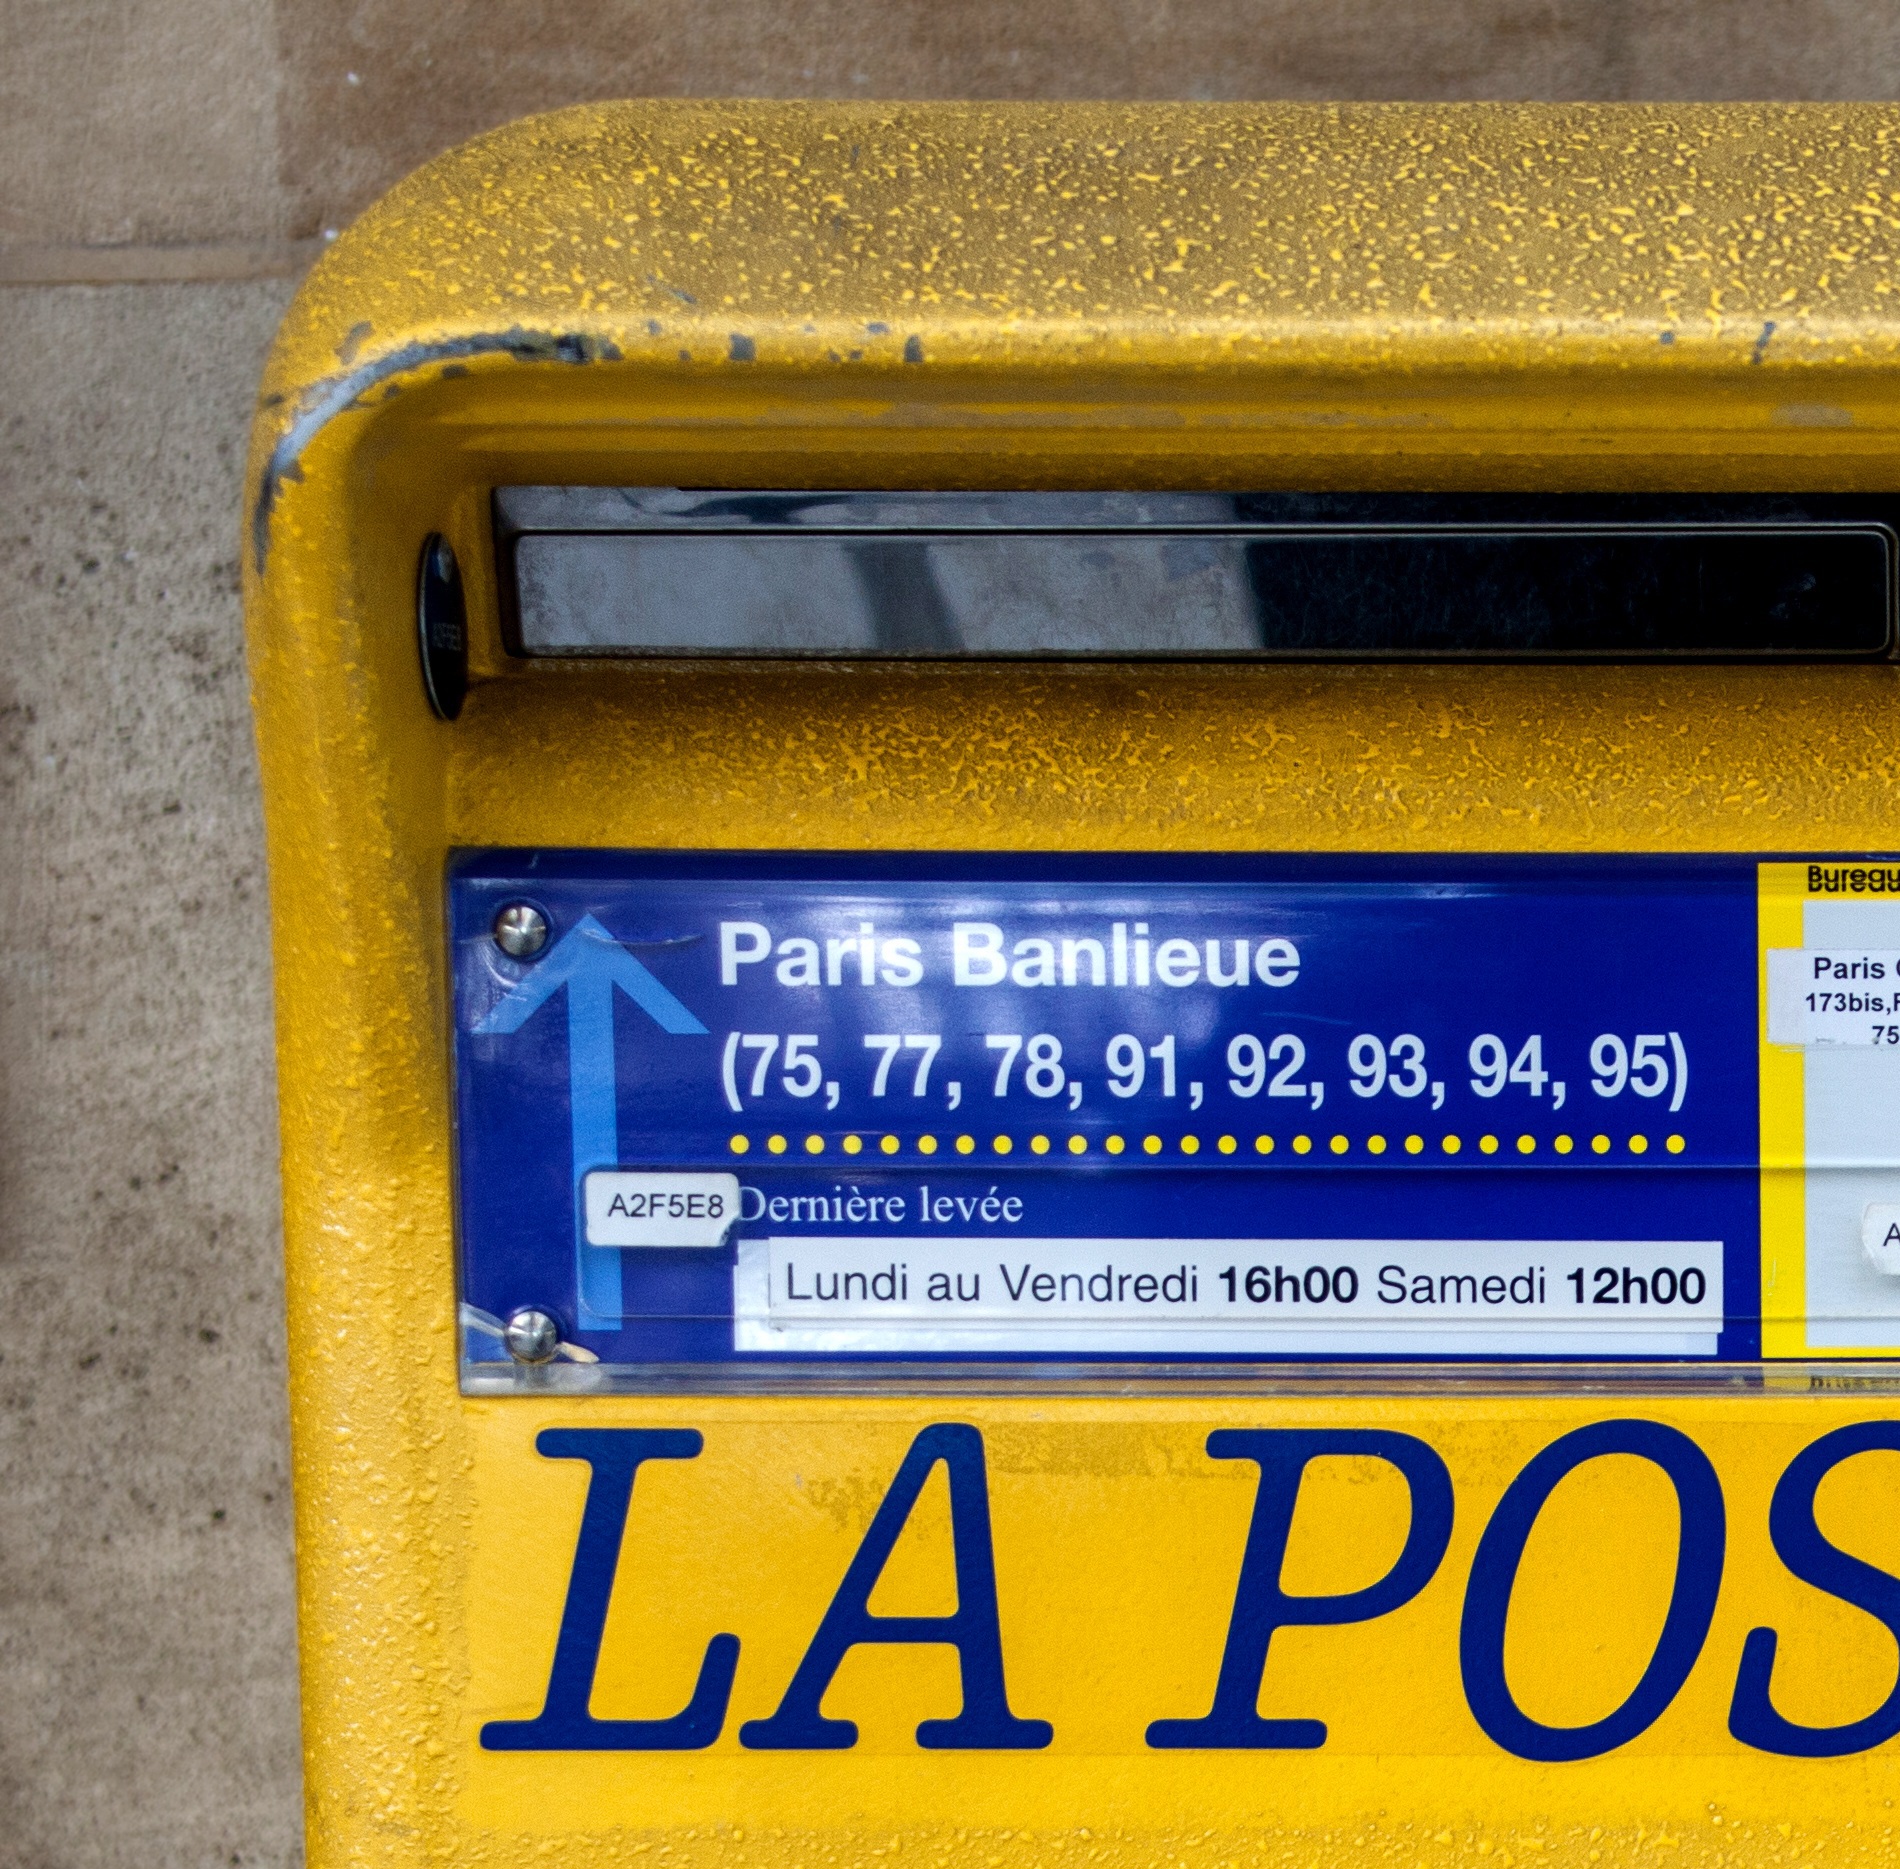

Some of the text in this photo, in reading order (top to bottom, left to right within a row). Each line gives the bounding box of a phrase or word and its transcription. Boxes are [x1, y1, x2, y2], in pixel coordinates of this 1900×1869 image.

[719, 921, 1301, 988] Paris Banlieue
[1813, 956, 1886, 980] Paris
[722, 1031, 1689, 1112] (75, 77, 78, 91, 92, 93, 94, 95)
[607, 1193, 725, 1219] A2F5E8
[738, 1186, 1024, 1222] Dernière levée
[786, 1263, 1706, 1305] Lundi au Vendredi 16h00 Samedi 12h00
[478, 1423, 1054, 1751] LA
